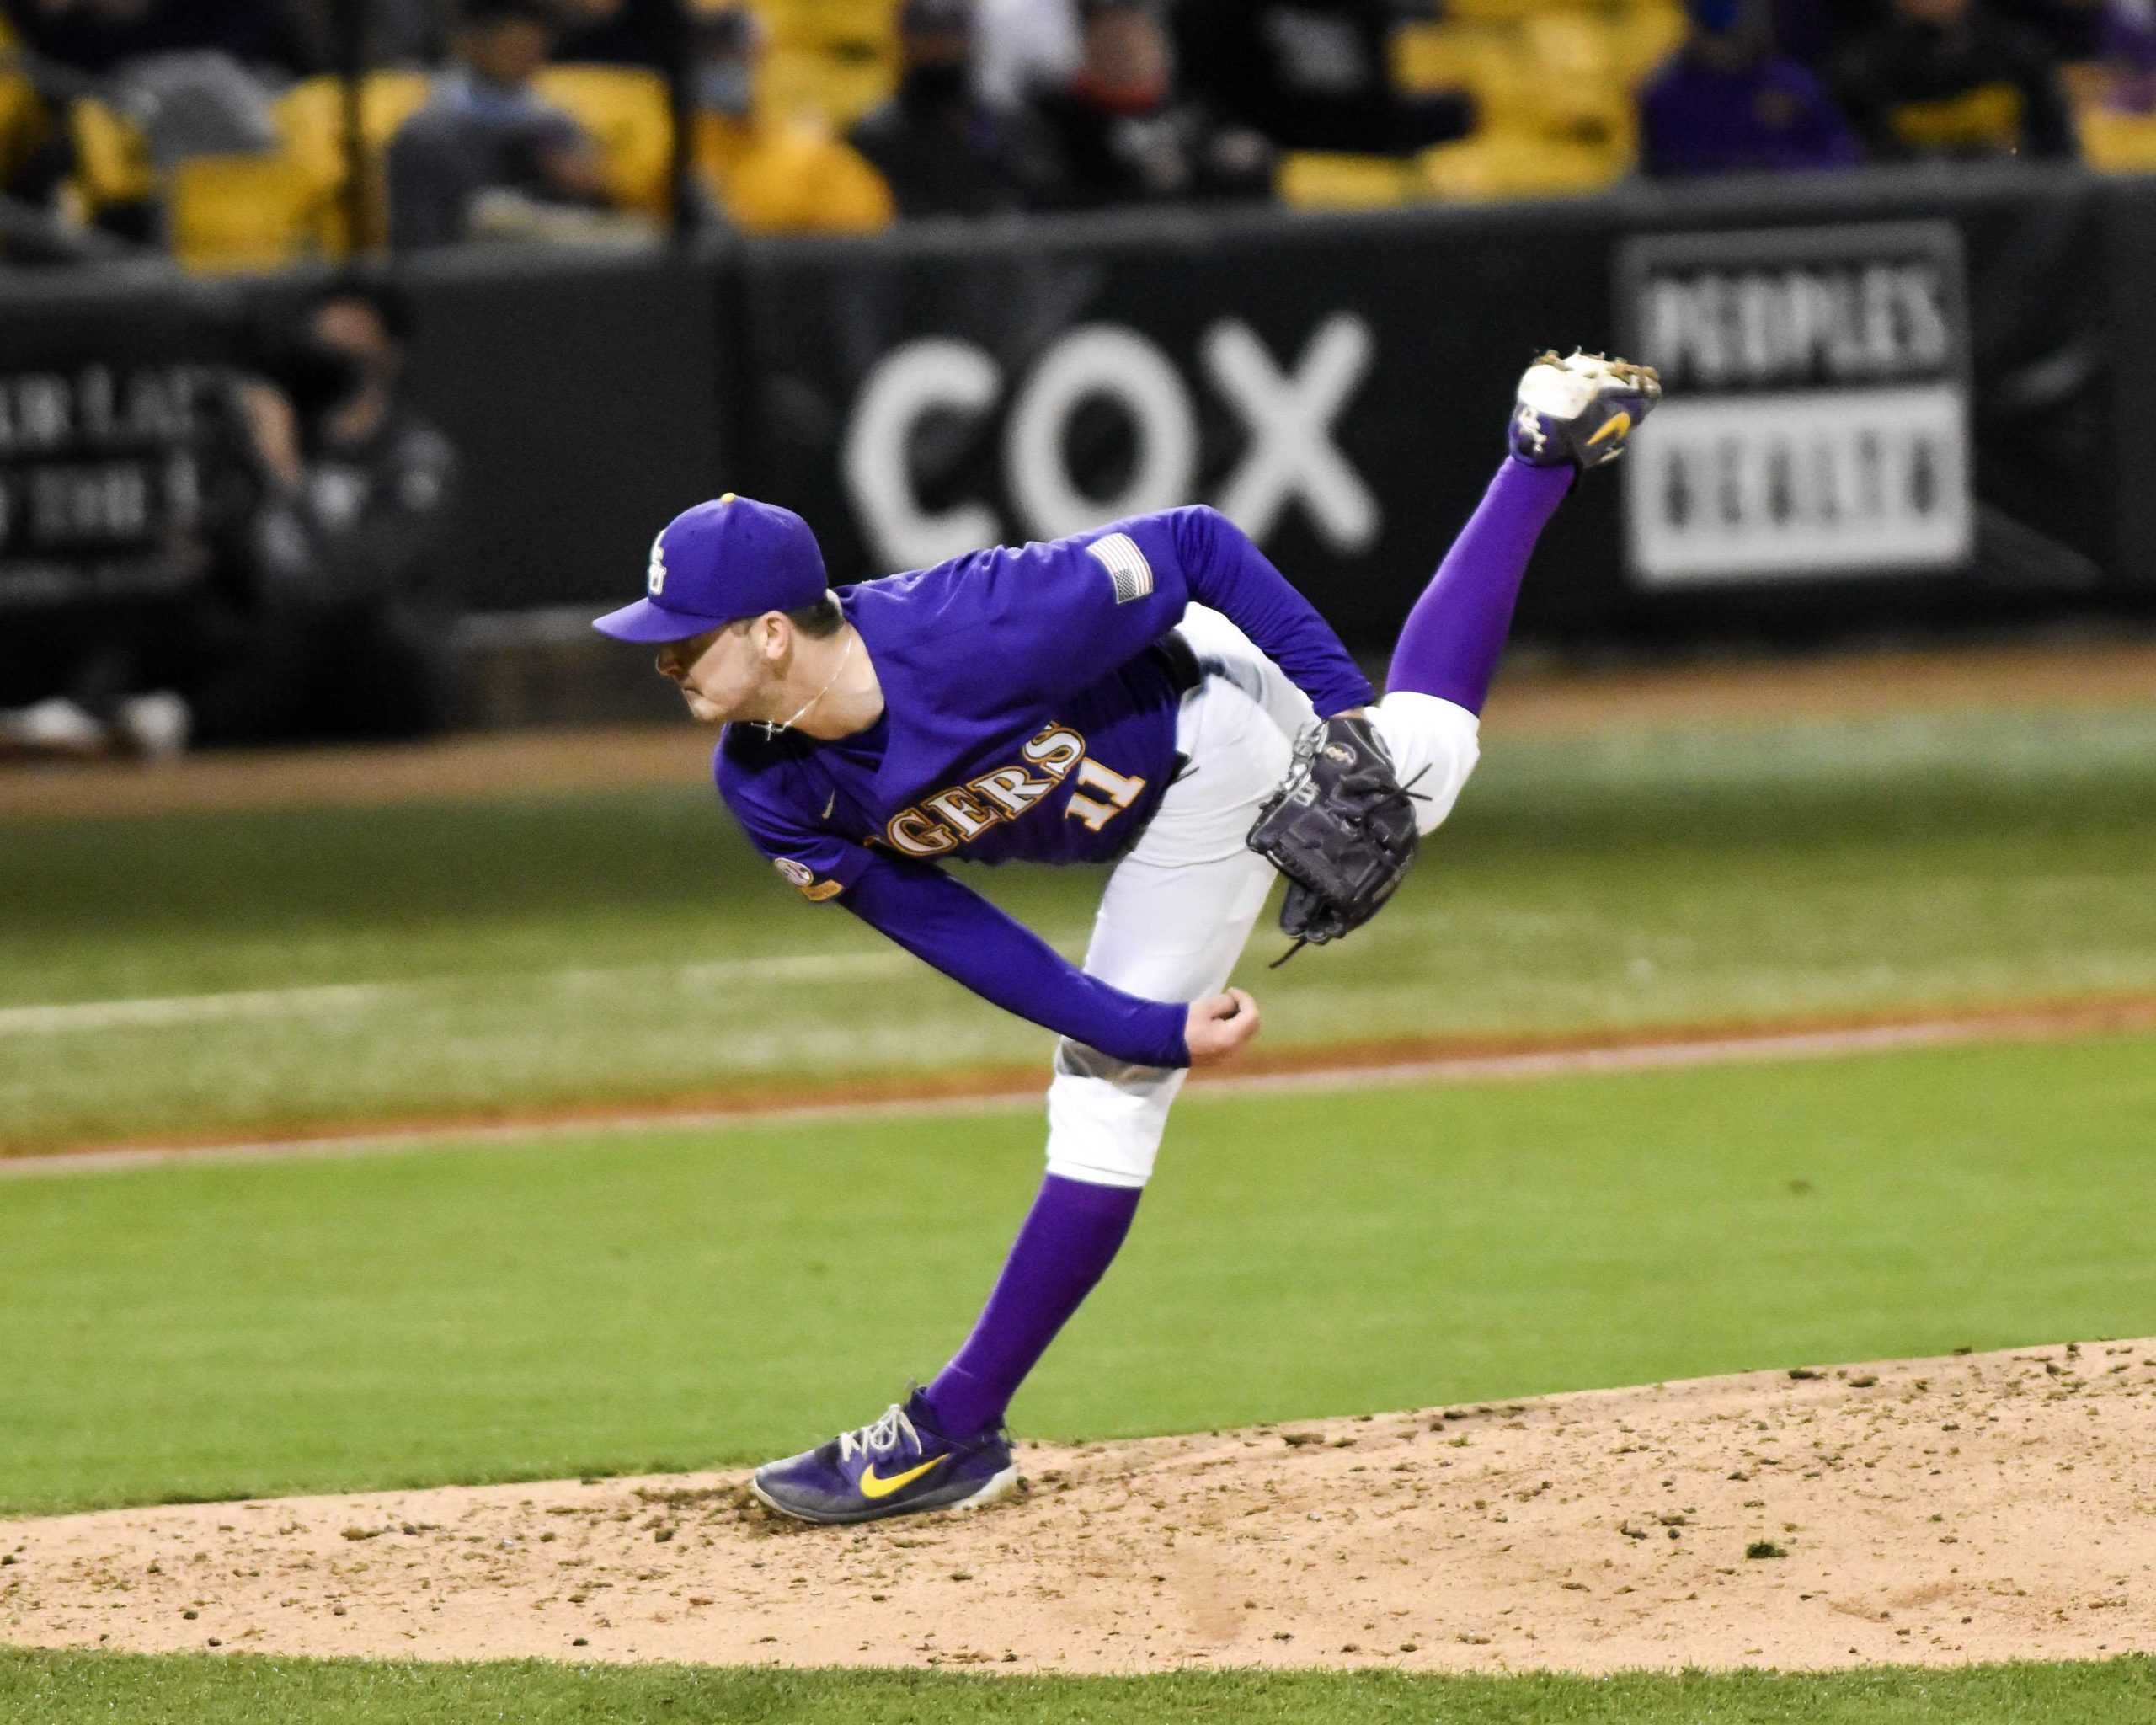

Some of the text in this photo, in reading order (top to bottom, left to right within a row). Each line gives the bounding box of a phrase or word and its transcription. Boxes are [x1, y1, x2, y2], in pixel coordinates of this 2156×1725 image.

[847, 315, 1374, 574] COX
[864, 721, 1086, 857] GERS
[1065, 756, 1146, 832] 11
